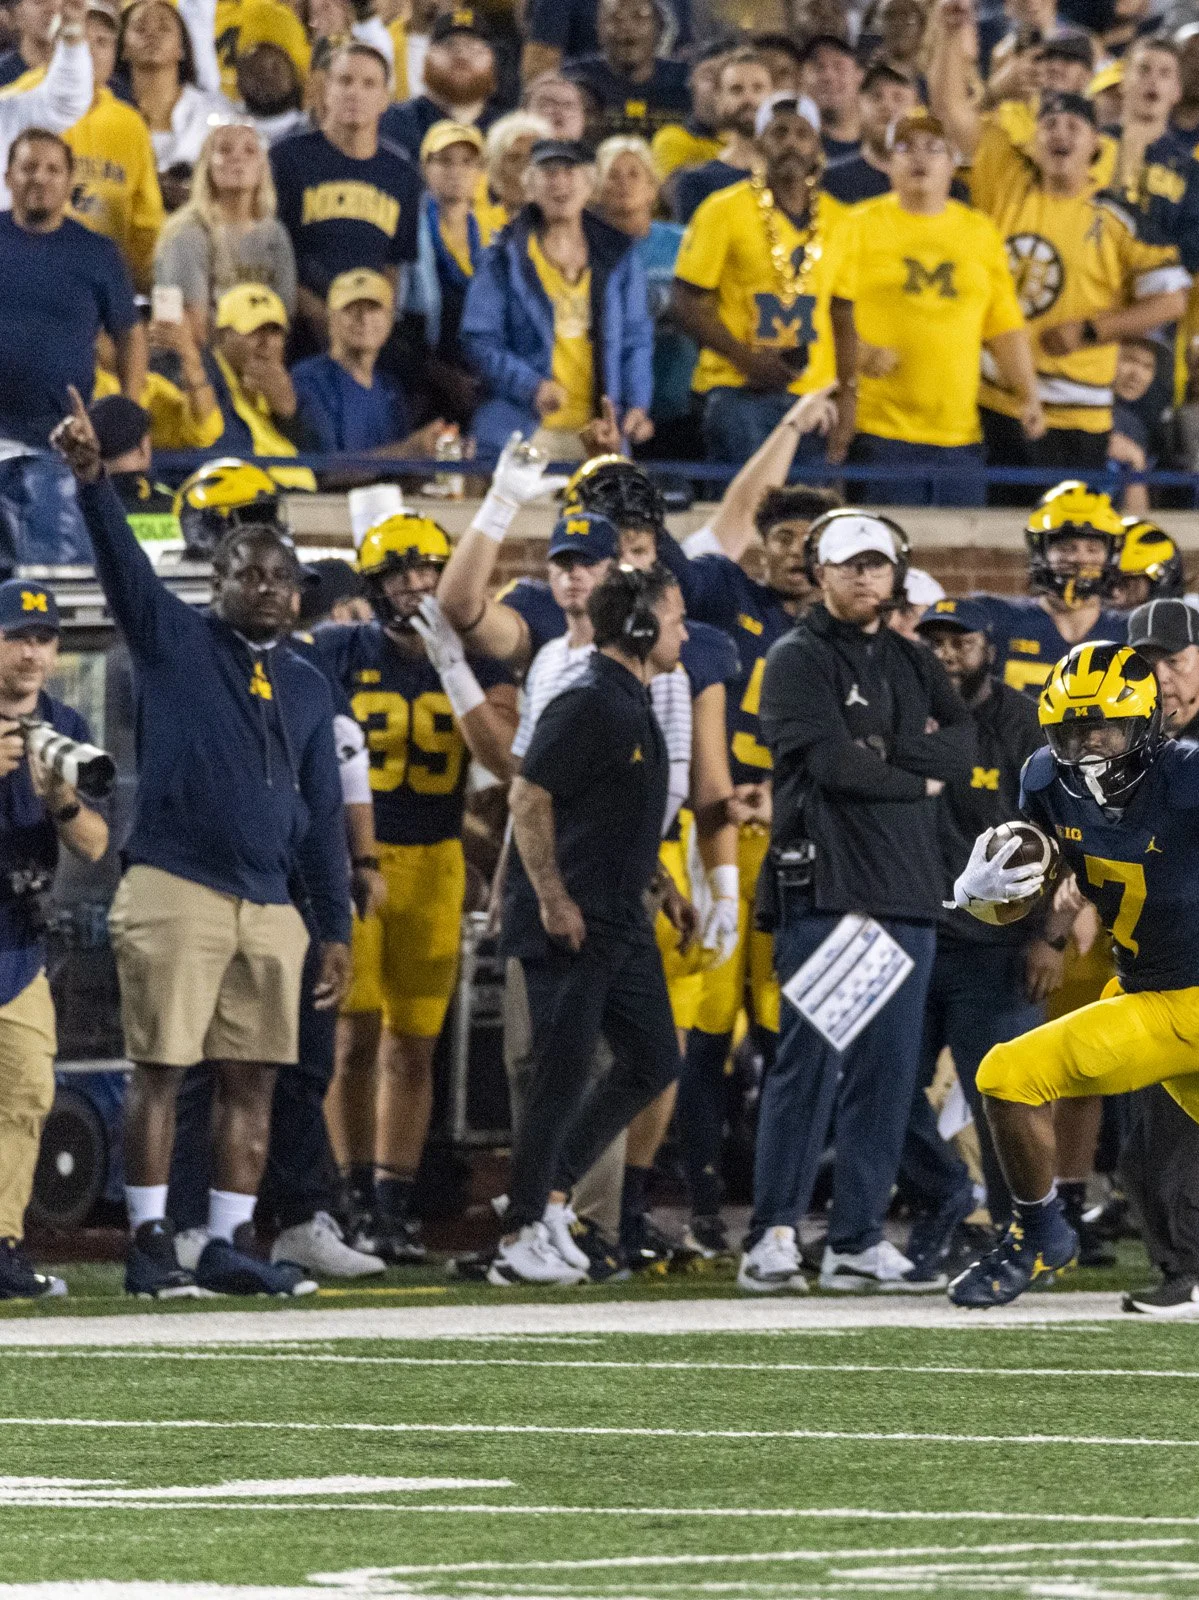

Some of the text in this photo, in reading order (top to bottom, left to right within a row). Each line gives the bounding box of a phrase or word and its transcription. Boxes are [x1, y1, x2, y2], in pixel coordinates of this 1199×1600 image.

[902, 258, 956, 299] M
[753, 294, 818, 343] M
[1074, 707, 1088, 717] M
[350, 691, 467, 798] 39
[970, 767, 999, 791] M
[1080, 855, 1148, 956] 7
